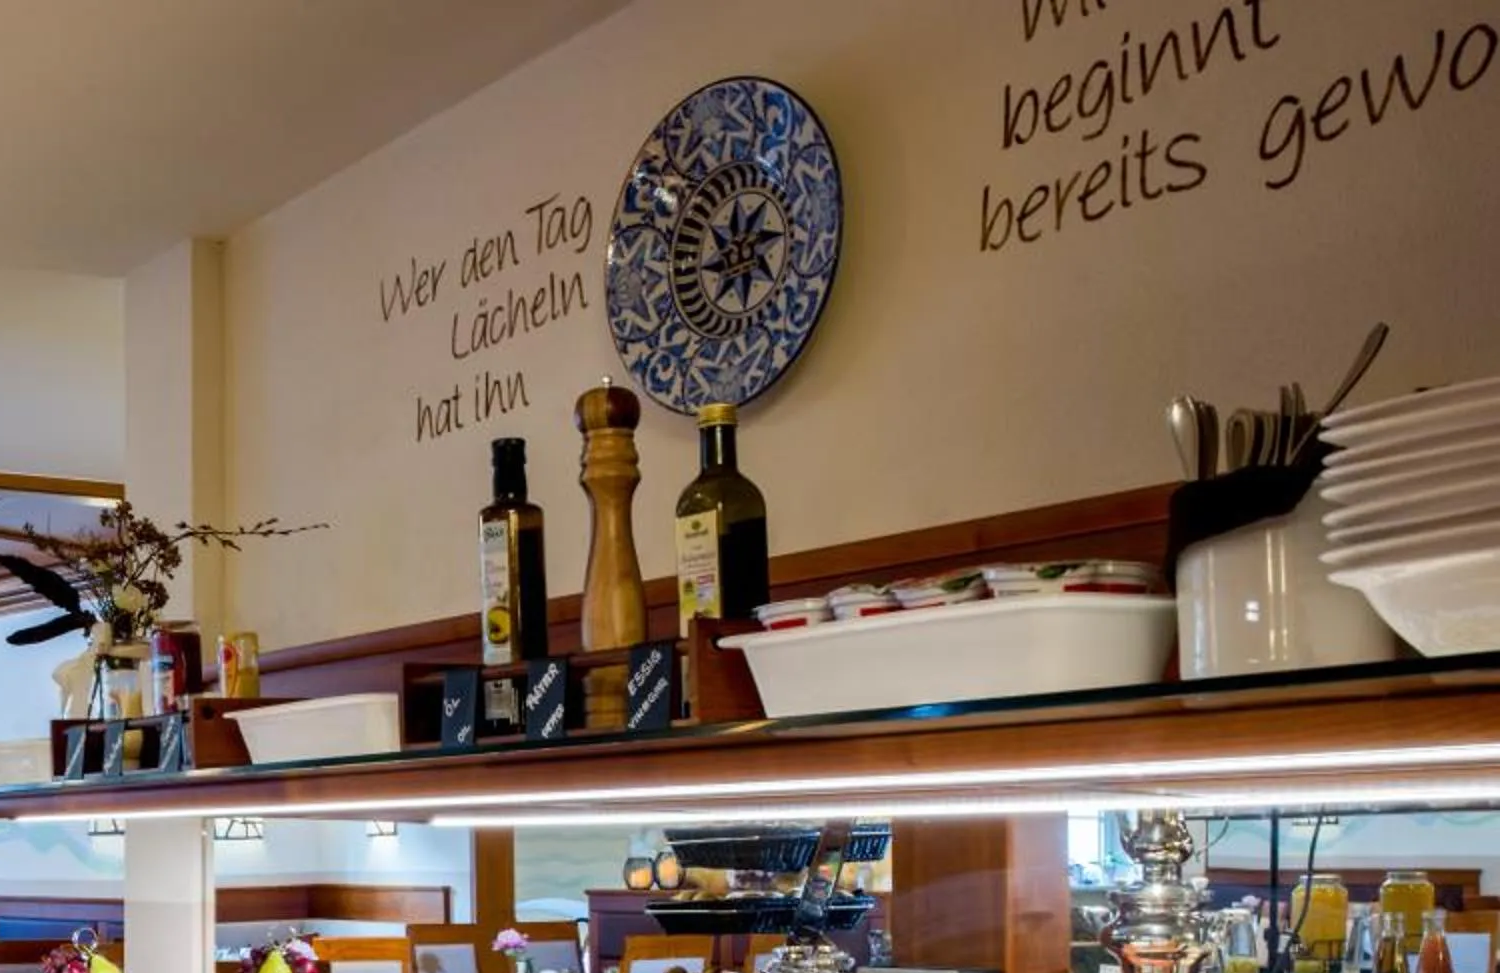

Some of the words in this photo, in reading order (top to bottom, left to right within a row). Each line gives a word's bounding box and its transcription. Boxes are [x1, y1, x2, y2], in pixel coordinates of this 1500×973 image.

[979, 129, 1207, 252] bereits
[1259, 23, 1499, 189] gewo
[1002, 0, 1280, 149] beginnt
[380, 256, 447, 322] Wer
[460, 229, 520, 289] den
[524, 193, 594, 255] Tag
[450, 271, 590, 360] Lächeln
[416, 384, 464, 442] hat
[474, 371, 531, 423] ihn
